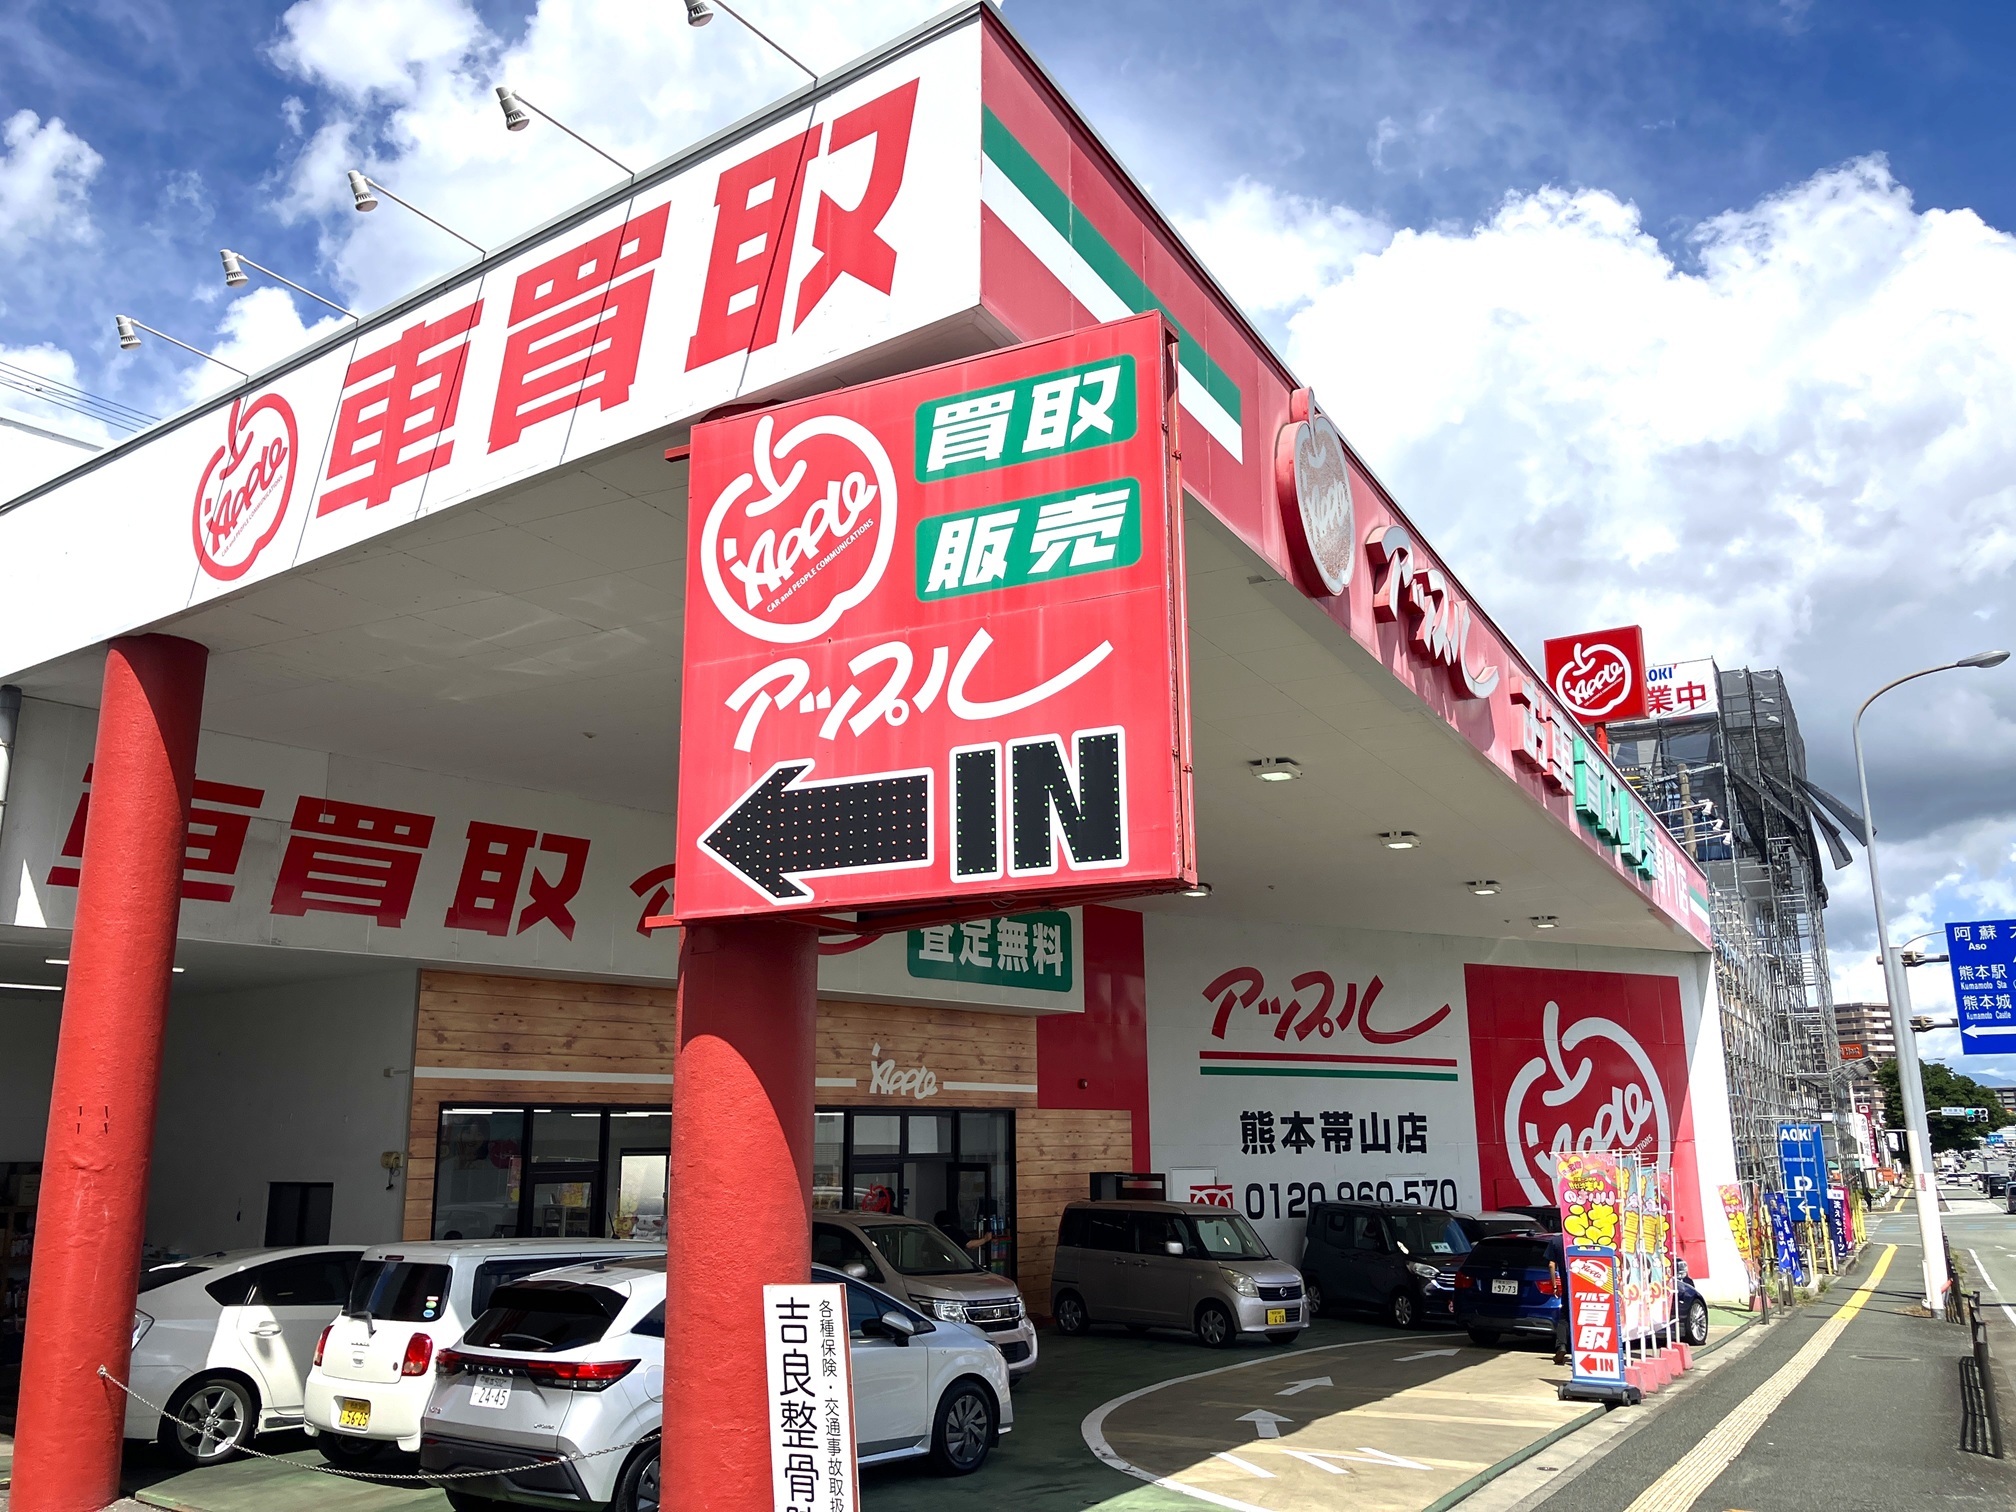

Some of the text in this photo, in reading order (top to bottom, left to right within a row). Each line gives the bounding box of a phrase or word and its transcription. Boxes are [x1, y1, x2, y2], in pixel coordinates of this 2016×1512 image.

[316, 77, 920, 519] 車買取
[926, 365, 1122, 472] 買取
[925, 488, 1131, 592] 販売
[766, 518, 875, 613] CAR and PEOPLE COMMUNICATIONS
[725, 627, 1114, 752] アップル
[949, 725, 1129, 884] IN
[918, 916, 1064, 977] 査定無料
[1954, 925, 1998, 942] 阿蘇
[1968, 942, 1987, 951] Aso
[1958, 964, 2008, 981] 熊本駅
[1960, 981, 1994, 990] Kumamoto
[1202, 966, 1452, 1044] アップル
[1962, 994, 2012, 1010] 熊本城
[1966, 1010, 2012, 1020] Kumamoto Castle
[1240, 1110, 1428, 1155] 熊本帯山店
[1781, 1128, 1812, 1142] AOKI
[1575, 1292, 1611, 1302] クルマ
[1577, 1302, 1612, 1351] 買取
[1600, 1358, 1614, 1373] IN
[346, 1411, 368, 1427] 56-25
[478, 1387, 508, 1406] 24-45
[776, 1297, 819, 1512] 吉良整骨
[819, 1299, 845, 1512] 各種保険・交通事故取扱
